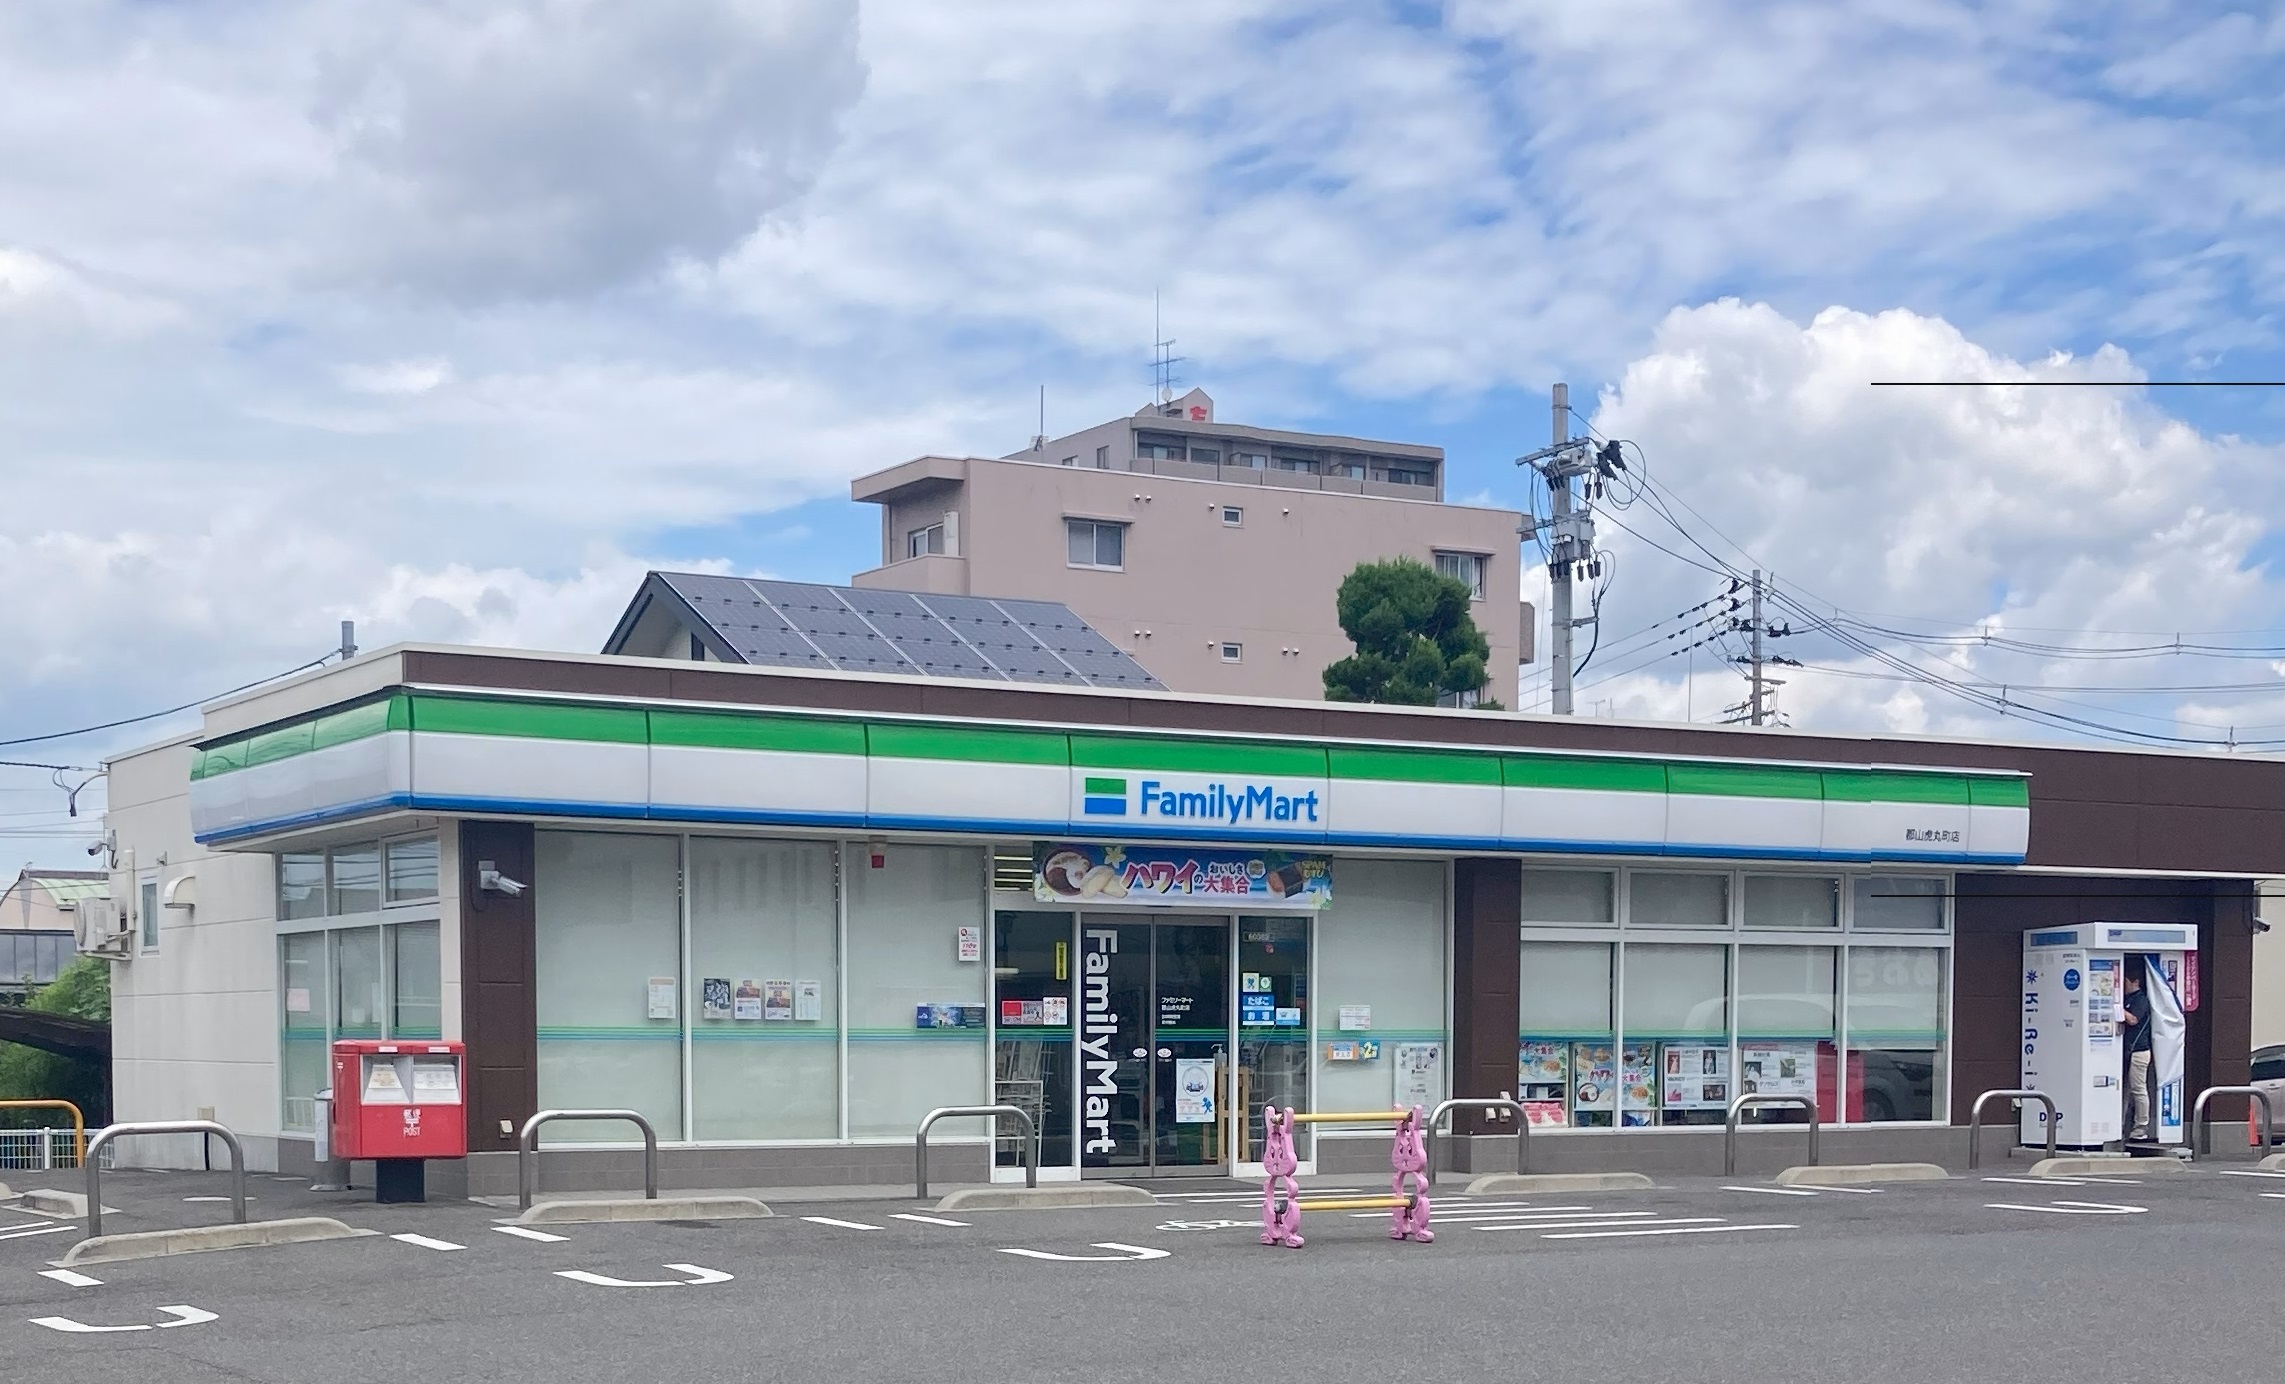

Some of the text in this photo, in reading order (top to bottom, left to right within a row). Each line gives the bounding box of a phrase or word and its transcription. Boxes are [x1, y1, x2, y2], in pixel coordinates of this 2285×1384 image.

[1141, 781, 1318, 825] FamilyMart
[1204, 876, 1251, 895] 大集合
[1247, 996, 1270, 1006] たばこ
[1081, 929, 1118, 1154] FamilyMart
[2039, 1112, 2064, 1122] DP
